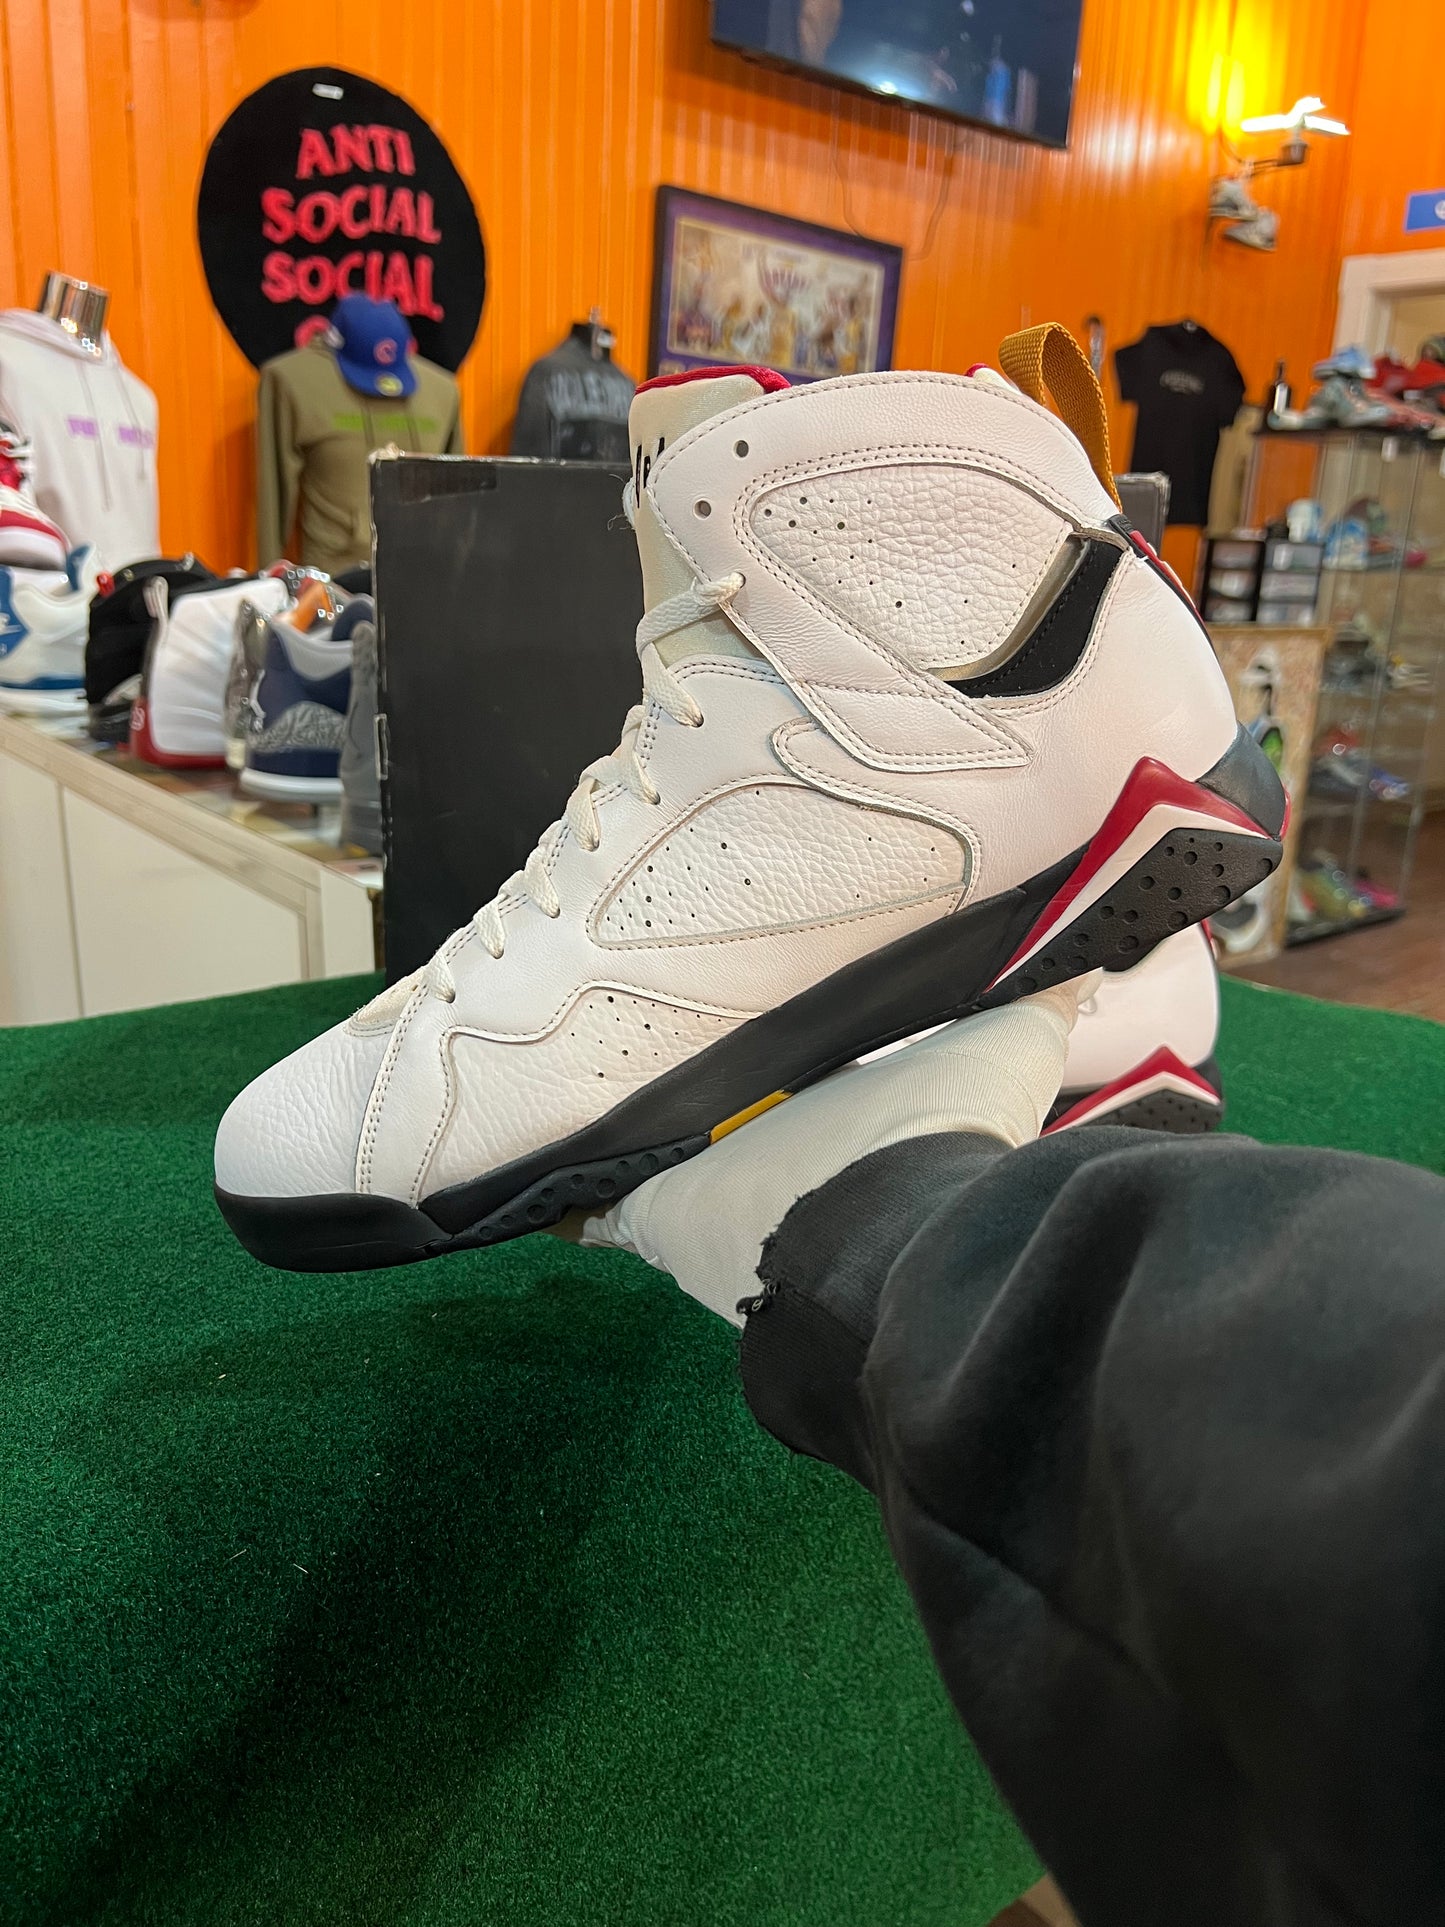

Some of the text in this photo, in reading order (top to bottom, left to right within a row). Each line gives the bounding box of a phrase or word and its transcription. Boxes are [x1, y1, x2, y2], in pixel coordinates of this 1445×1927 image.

[296, 124, 416, 179] ANTI
[261, 184, 441, 244] SOCIAL
[261, 251, 444, 322] SOCIAL
